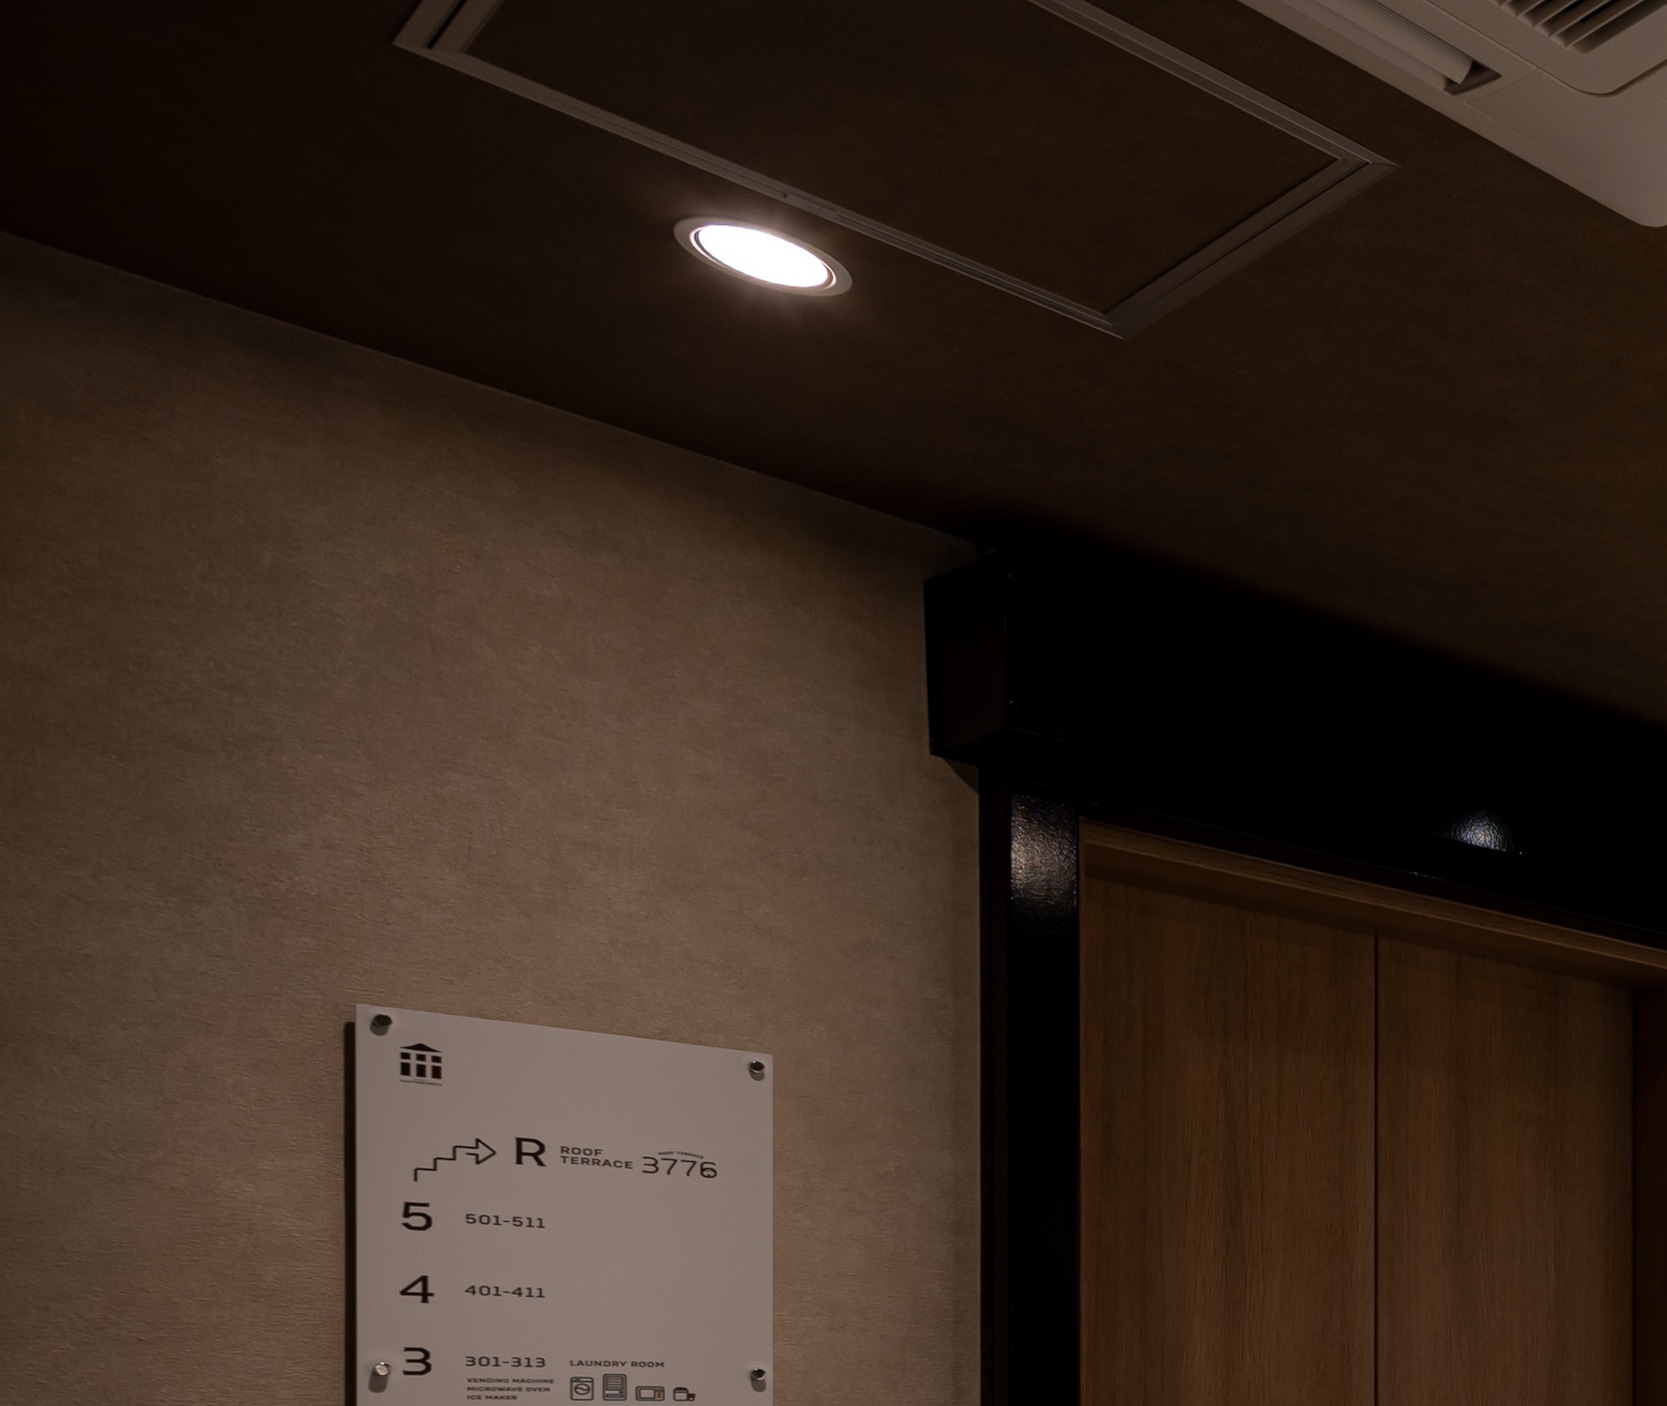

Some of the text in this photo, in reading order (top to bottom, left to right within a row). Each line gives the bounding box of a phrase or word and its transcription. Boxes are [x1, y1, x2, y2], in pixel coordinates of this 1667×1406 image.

[515, 1136, 546, 1167] R
[559, 1145, 603, 1157] ROOF
[559, 1155, 634, 1170] TERRACE
[641, 1156, 718, 1179] 3776
[401, 1201, 546, 1232] 5 501-511
[399, 1275, 546, 1304] 4 401-411
[402, 1346, 546, 1377] 3 301-313
[569, 1359, 665, 1369] LAUNDRY ROOM
[466, 1385, 523, 1393] MICROWAVE
